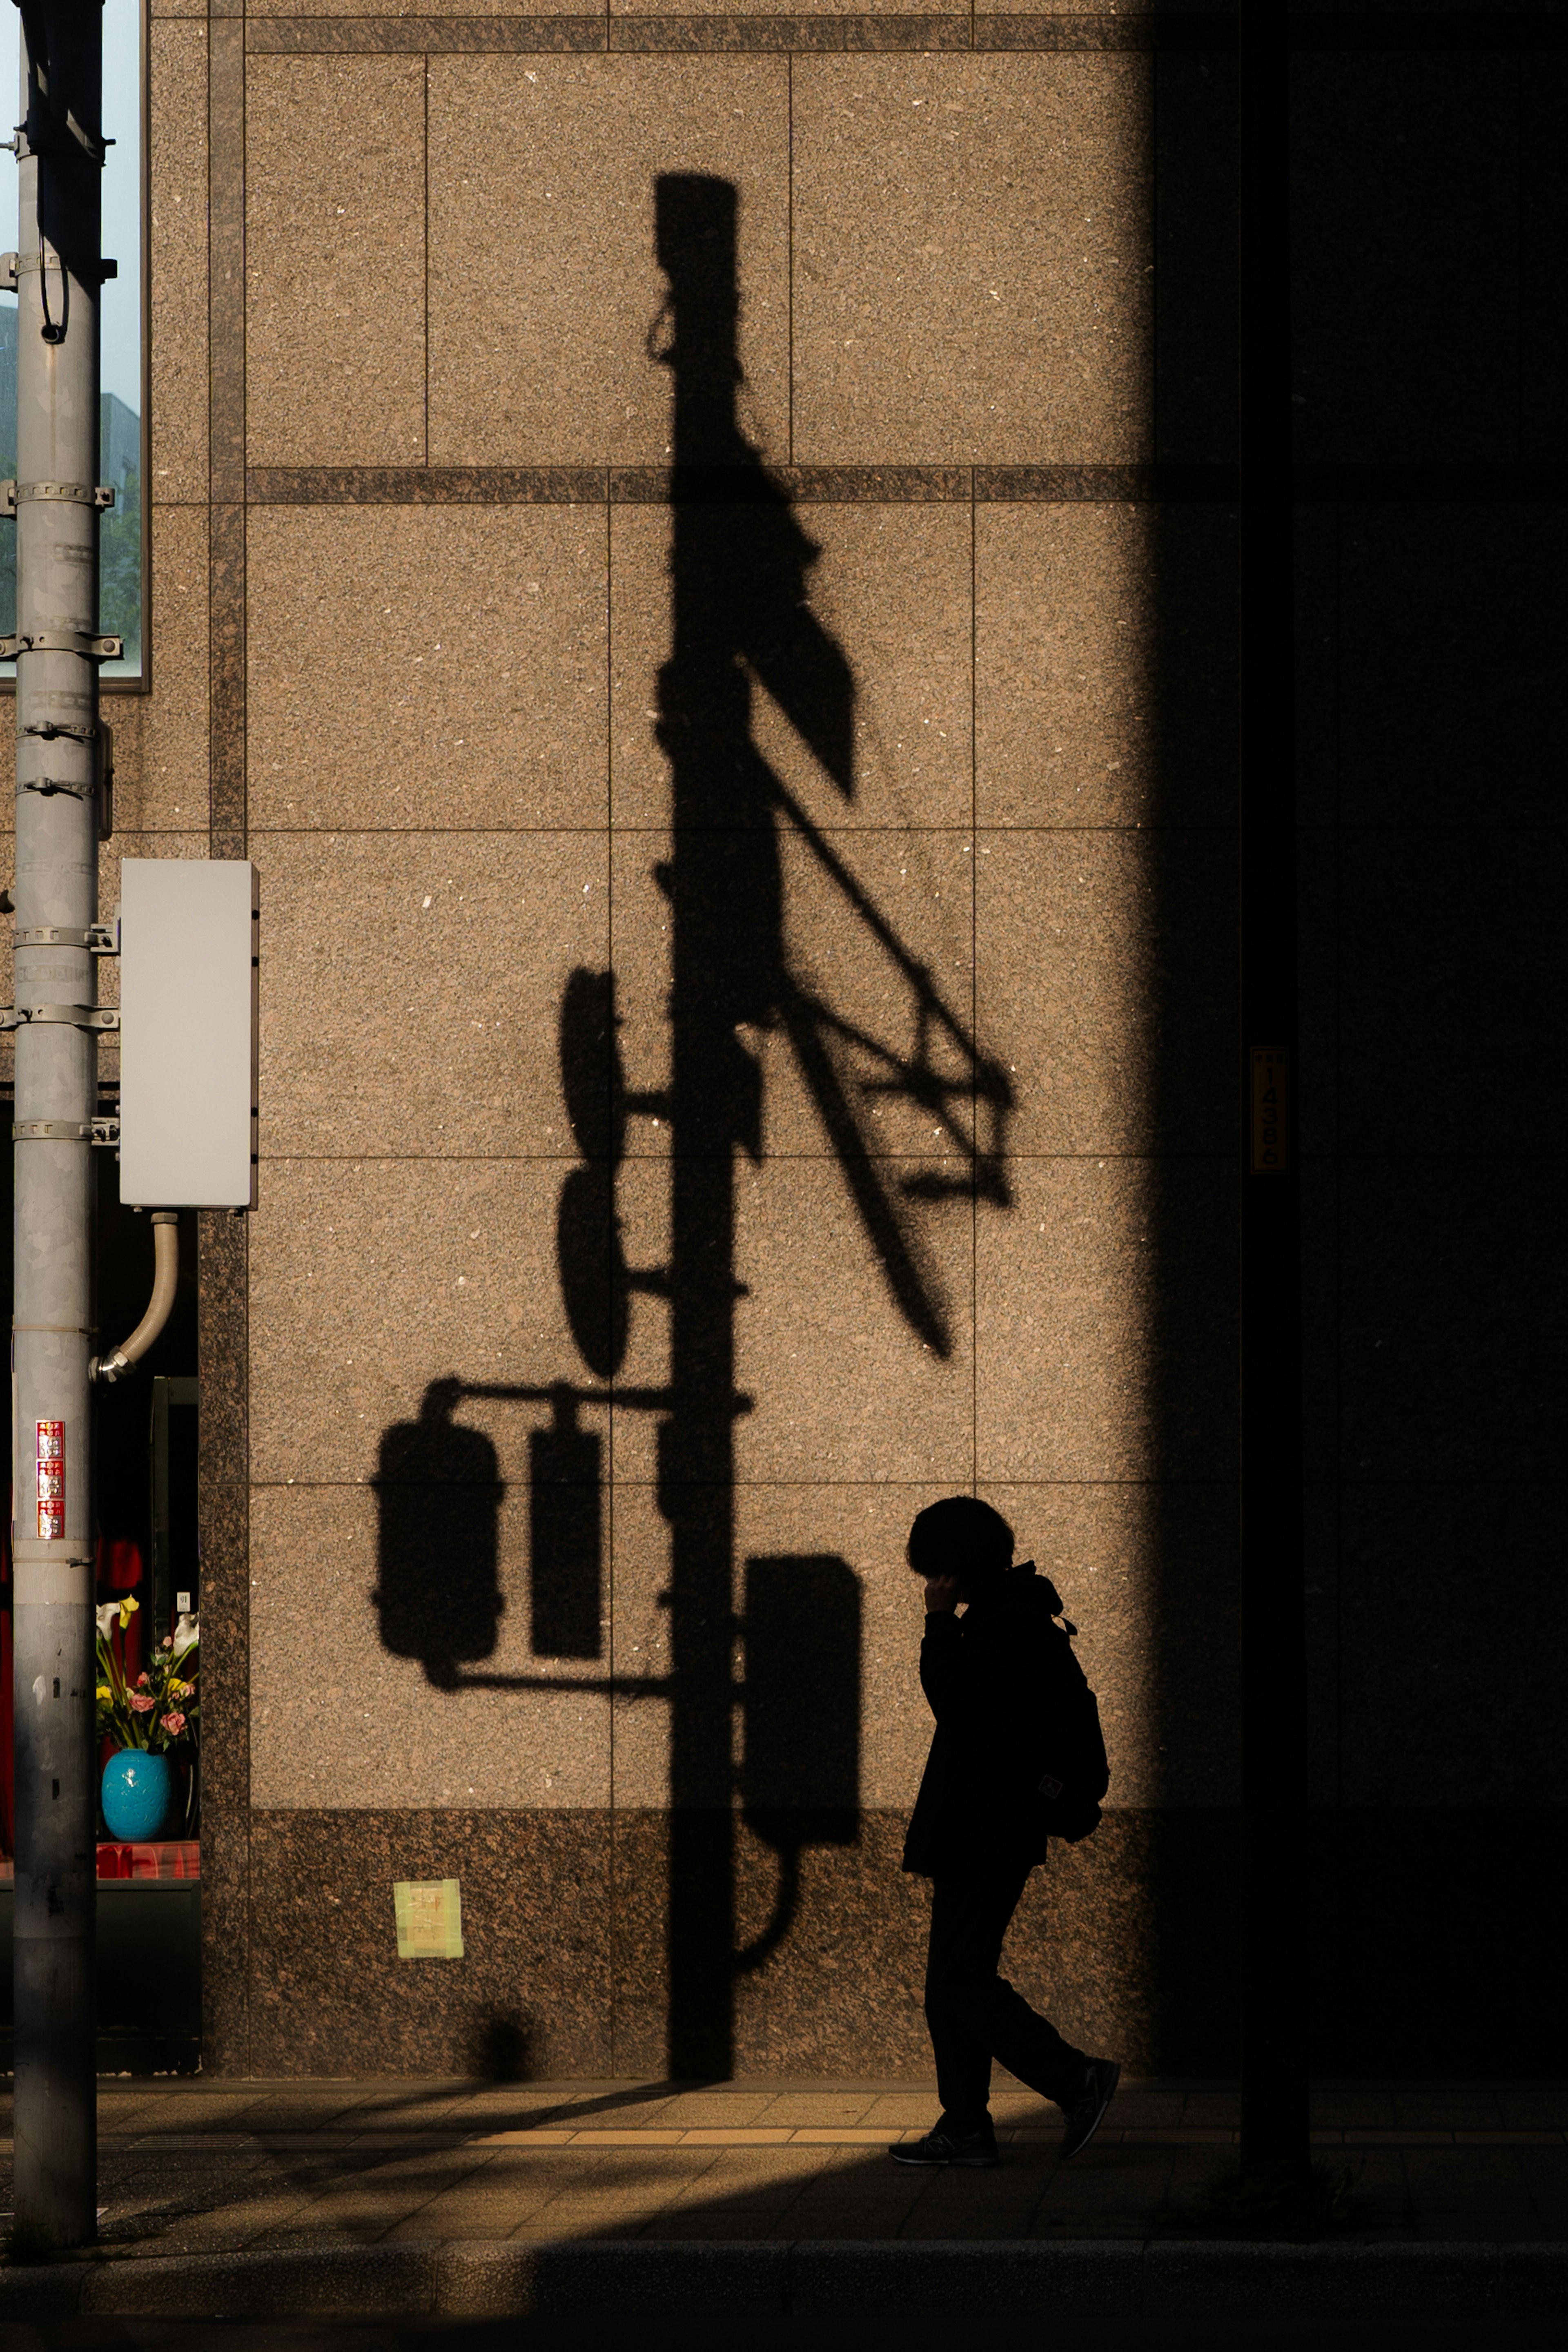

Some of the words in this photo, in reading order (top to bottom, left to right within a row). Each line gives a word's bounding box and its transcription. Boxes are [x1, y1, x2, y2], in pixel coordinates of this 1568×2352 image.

[1255, 1053, 1285, 1063] 中央区
[1263, 1067, 1277, 1164] 14386
